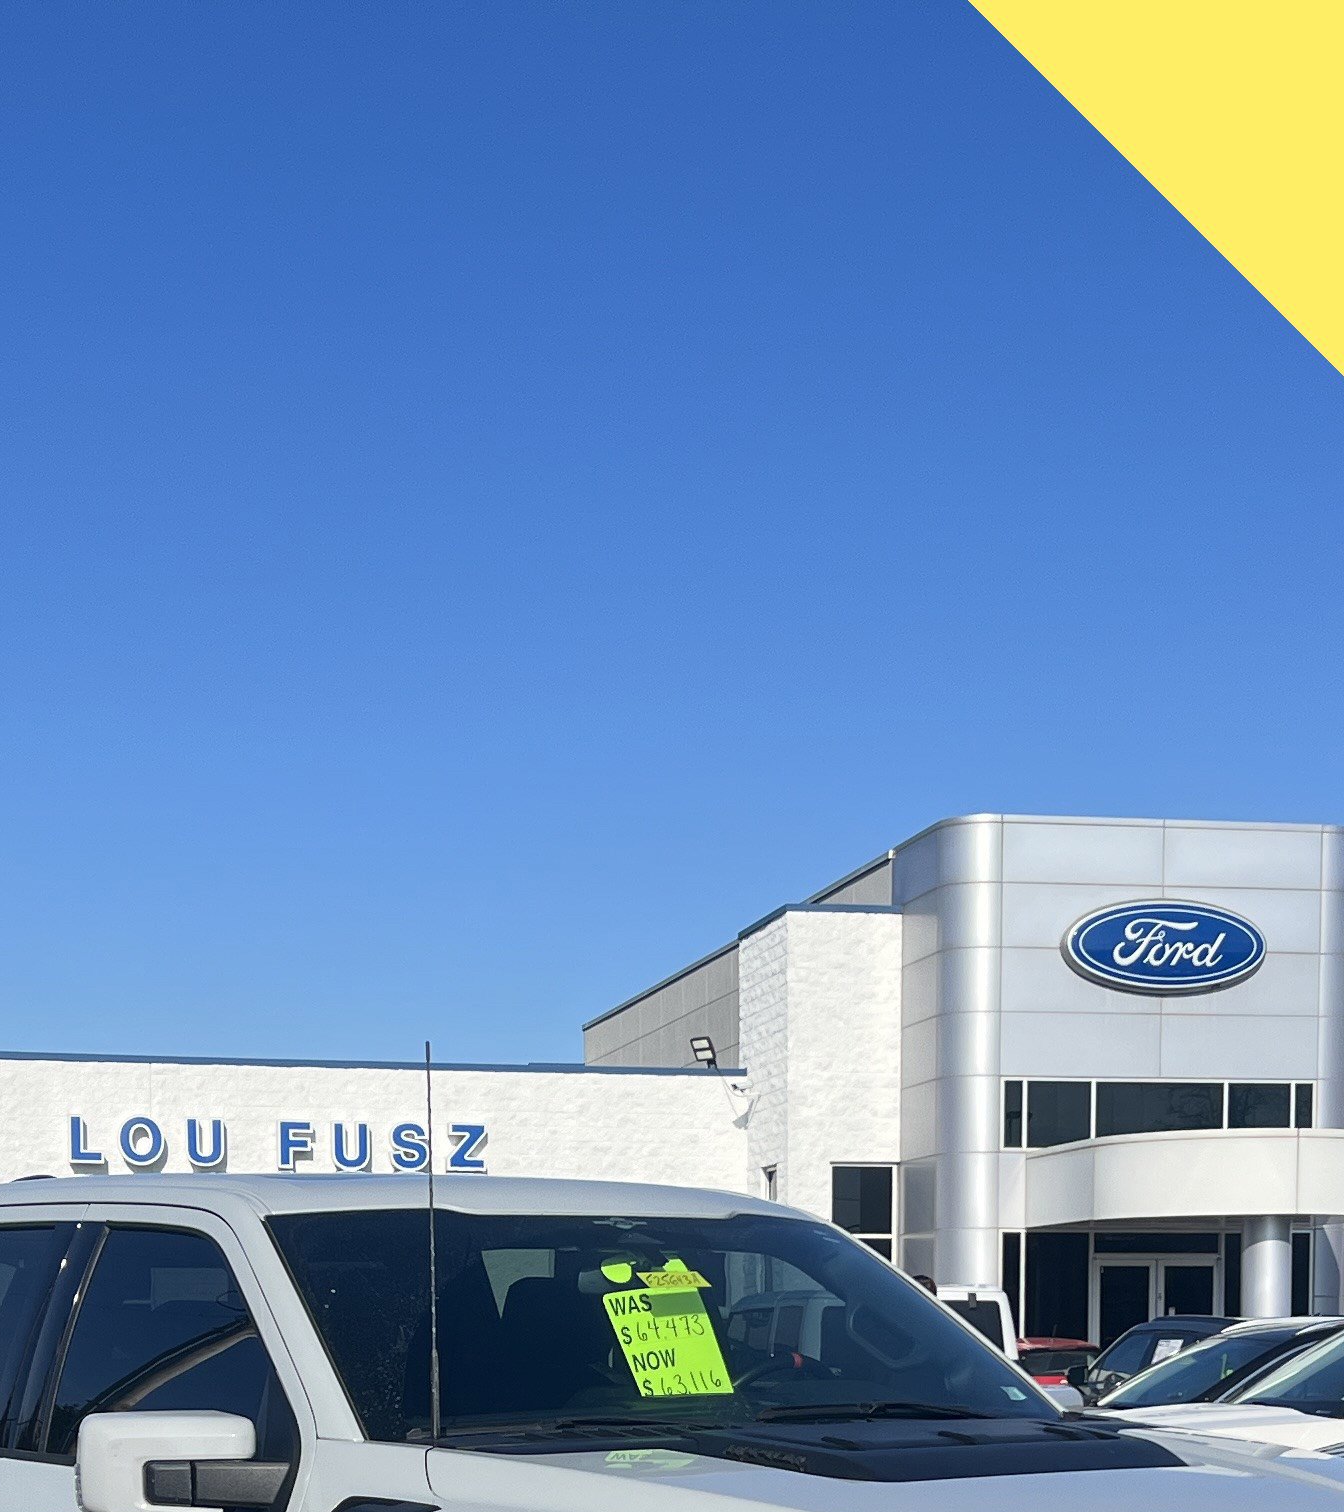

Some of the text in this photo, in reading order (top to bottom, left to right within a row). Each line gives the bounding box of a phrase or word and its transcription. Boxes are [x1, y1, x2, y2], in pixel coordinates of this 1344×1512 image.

[1113, 917, 1226, 967] Ford
[69, 1115, 488, 1172] LOU FUSZ
[608, 1294, 652, 1316] WAS
[632, 1348, 675, 1373] NOW
